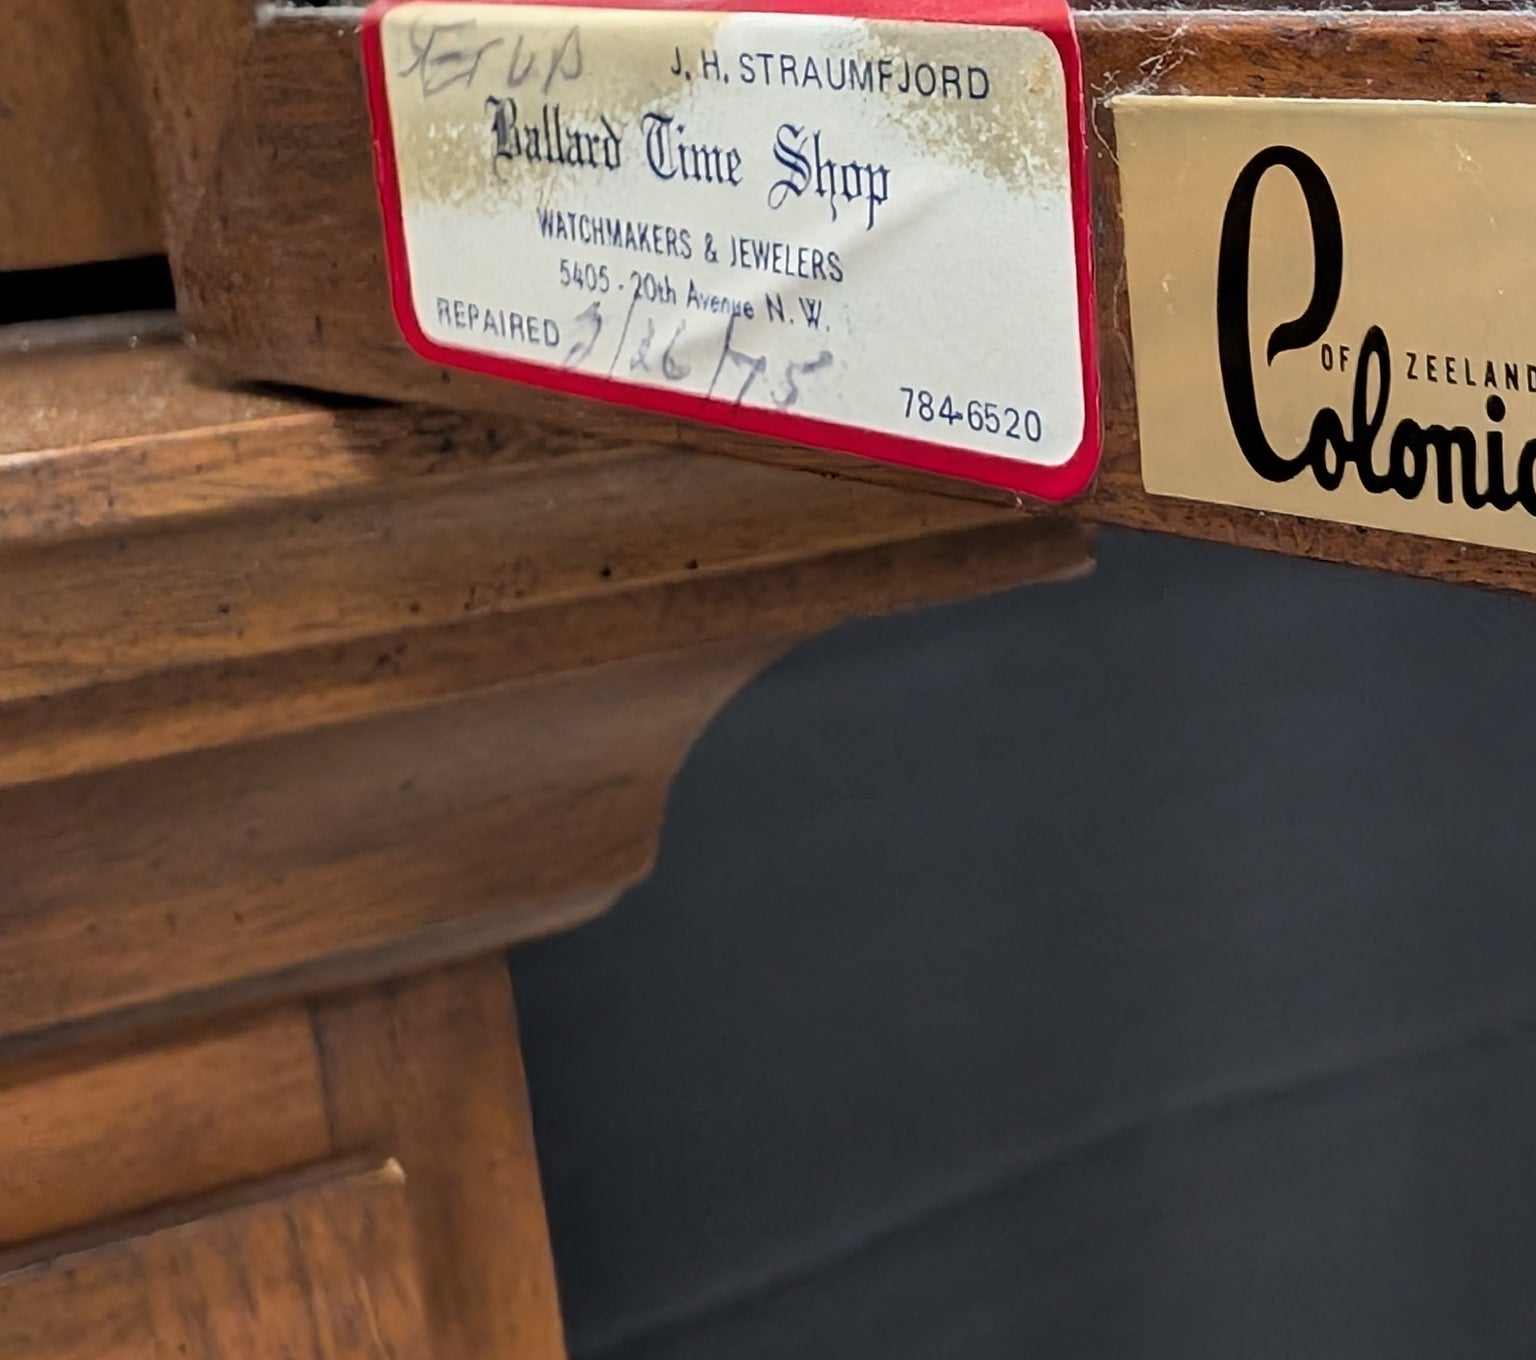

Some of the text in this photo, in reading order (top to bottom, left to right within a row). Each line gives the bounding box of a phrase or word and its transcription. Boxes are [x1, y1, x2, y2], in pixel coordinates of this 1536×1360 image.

[670, 46, 990, 100] J. H. STRAUMFJORD
[484, 95, 890, 231] Ballard Time Shop
[537, 206, 844, 283] WATCHMAKERS & JEWELERS
[437, 297, 561, 348] REPAIRED
[559, 258, 611, 293] 5405
[630, 270, 677, 306] 20th
[686, 278, 756, 320] Avenue
[766, 293, 794, 326] N.
[799, 296, 831, 332] W.
[1321, 343, 1350, 372] OF
[899, 387, 1043, 443] 784-6520
